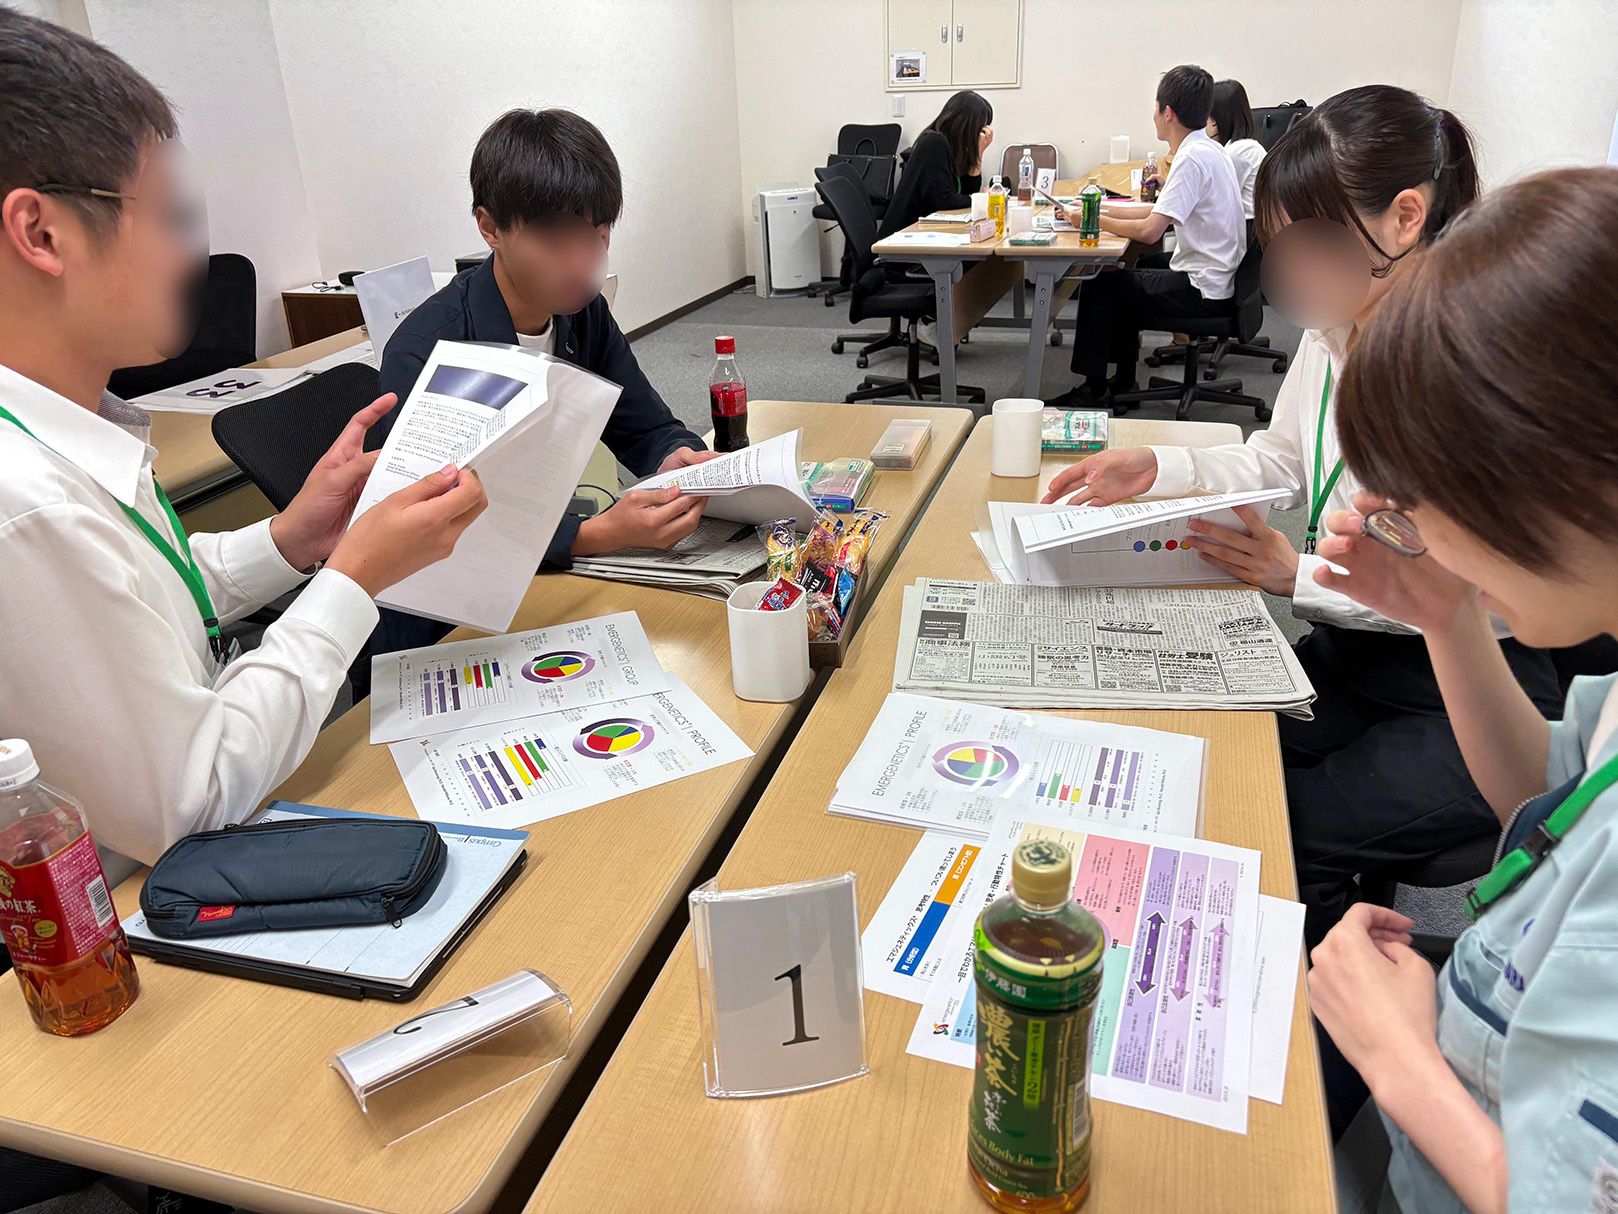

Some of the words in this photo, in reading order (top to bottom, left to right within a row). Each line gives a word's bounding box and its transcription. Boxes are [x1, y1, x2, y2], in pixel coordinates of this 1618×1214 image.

[1040, 175, 1050, 189] 3
[1220, 650, 1257, 658] ジュリスト
[622, 665, 639, 686] GROUP
[905, 710, 928, 739] PROFILE
[687, 729, 717, 755] PROFILE
[468, 838, 501, 848] Campus
[915, 894, 931, 912] 思考特性
[984, 968, 1027, 998] 伊藤園
[774, 963, 820, 1047] 1
[988, 1140, 1014, 1163] Body
[1018, 1154, 1034, 1166] Fat
